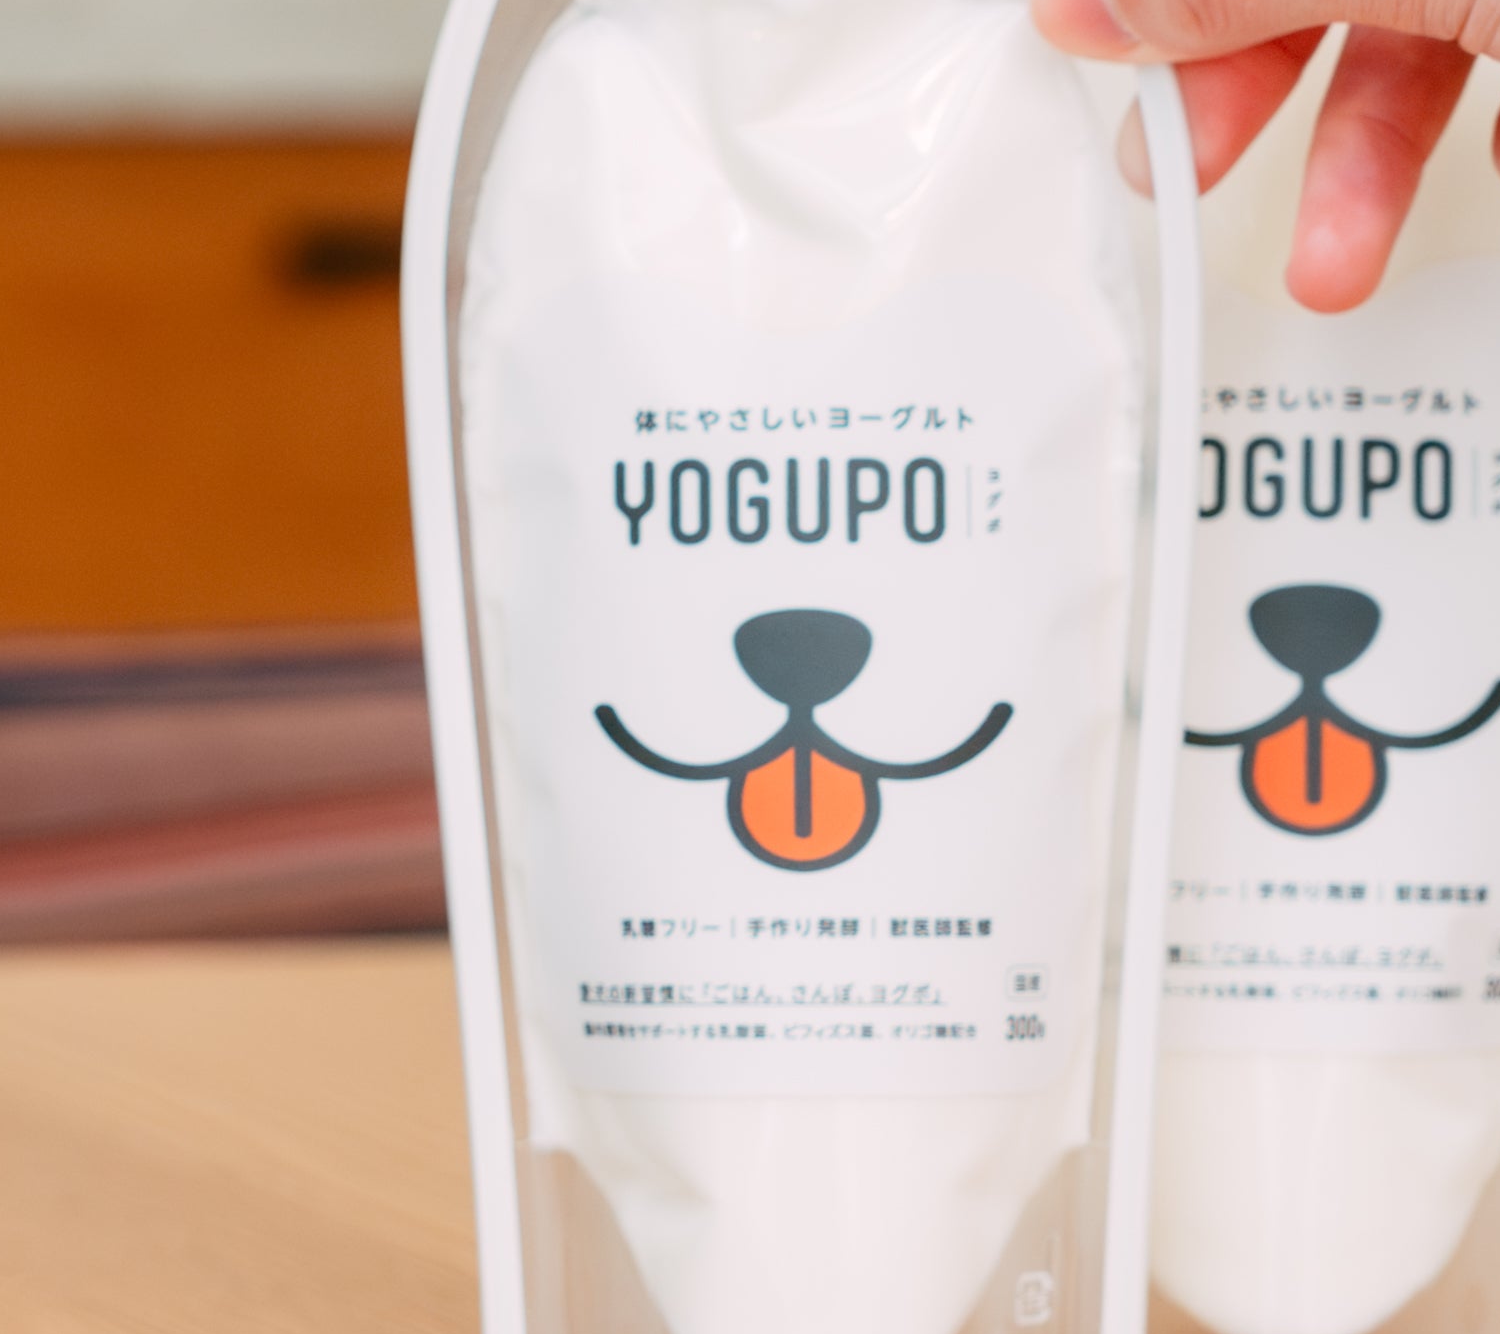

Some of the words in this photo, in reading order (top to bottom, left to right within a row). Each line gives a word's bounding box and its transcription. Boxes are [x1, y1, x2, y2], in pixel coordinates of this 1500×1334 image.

[635, 405, 973, 434] 体にやさしいヨーグルト
[614, 457, 946, 546] YOGUPO
